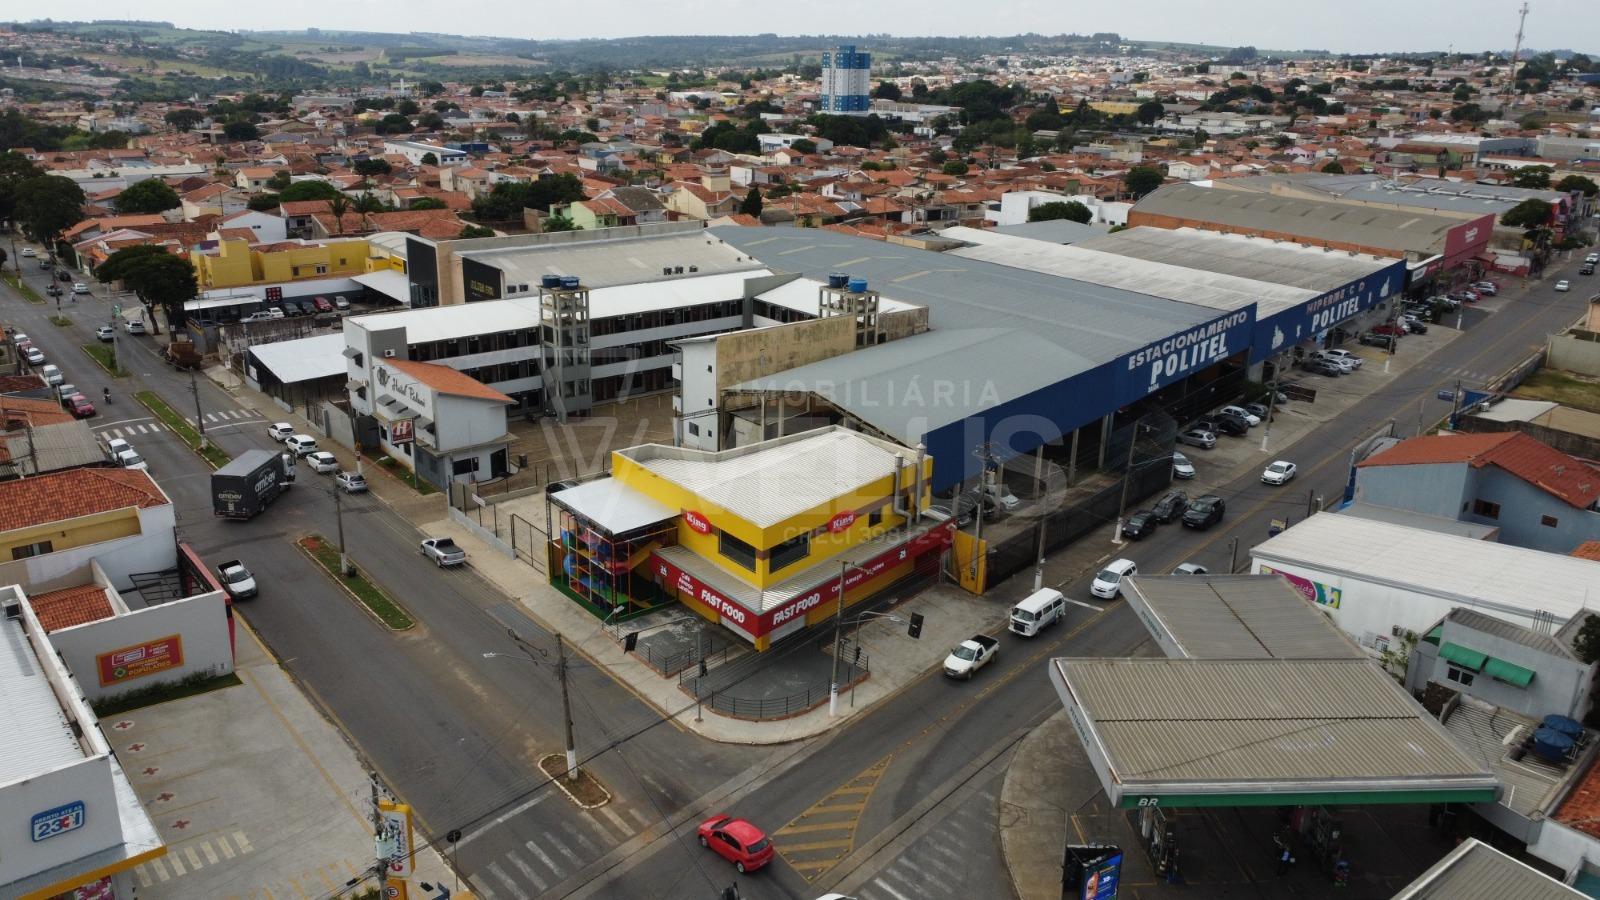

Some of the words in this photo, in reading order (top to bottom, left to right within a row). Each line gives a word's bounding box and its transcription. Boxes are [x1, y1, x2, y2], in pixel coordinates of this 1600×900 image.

[1311, 296, 1360, 333] POLITEL
[1128, 311, 1247, 370] ESTACIONAMENTO
[1150, 332, 1227, 384] POLITEL
[391, 377, 408, 396] Hotel
[255, 471, 276, 493] ambev
[686, 511, 707, 532] King
[833, 514, 854, 529] King
[701, 589, 721, 609] FAST
[722, 601, 745, 624] FOOD
[773, 604, 796, 625] FAST
[796, 592, 820, 614] FOOD
[1138, 797, 1158, 807] BR
